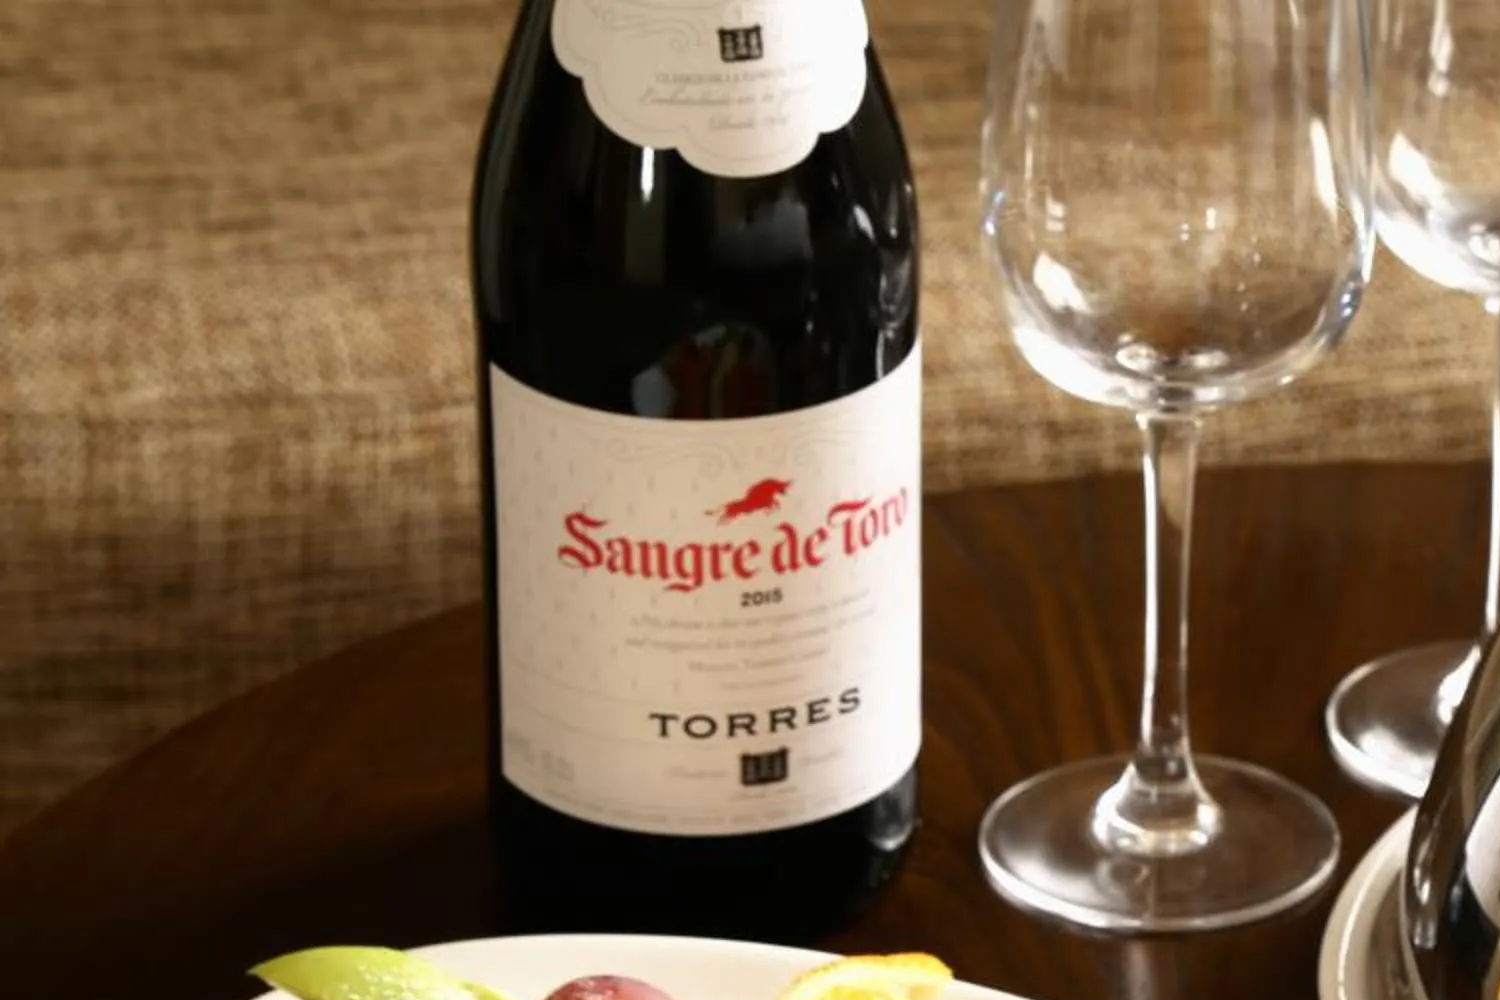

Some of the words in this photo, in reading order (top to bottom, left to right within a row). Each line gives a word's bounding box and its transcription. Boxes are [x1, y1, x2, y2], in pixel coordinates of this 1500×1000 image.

[558, 511, 763, 593] Sangre
[770, 522, 829, 575] de
[827, 486, 908, 556] Toro
[739, 588, 784, 608] 2015
[648, 687, 862, 740] TORRES
